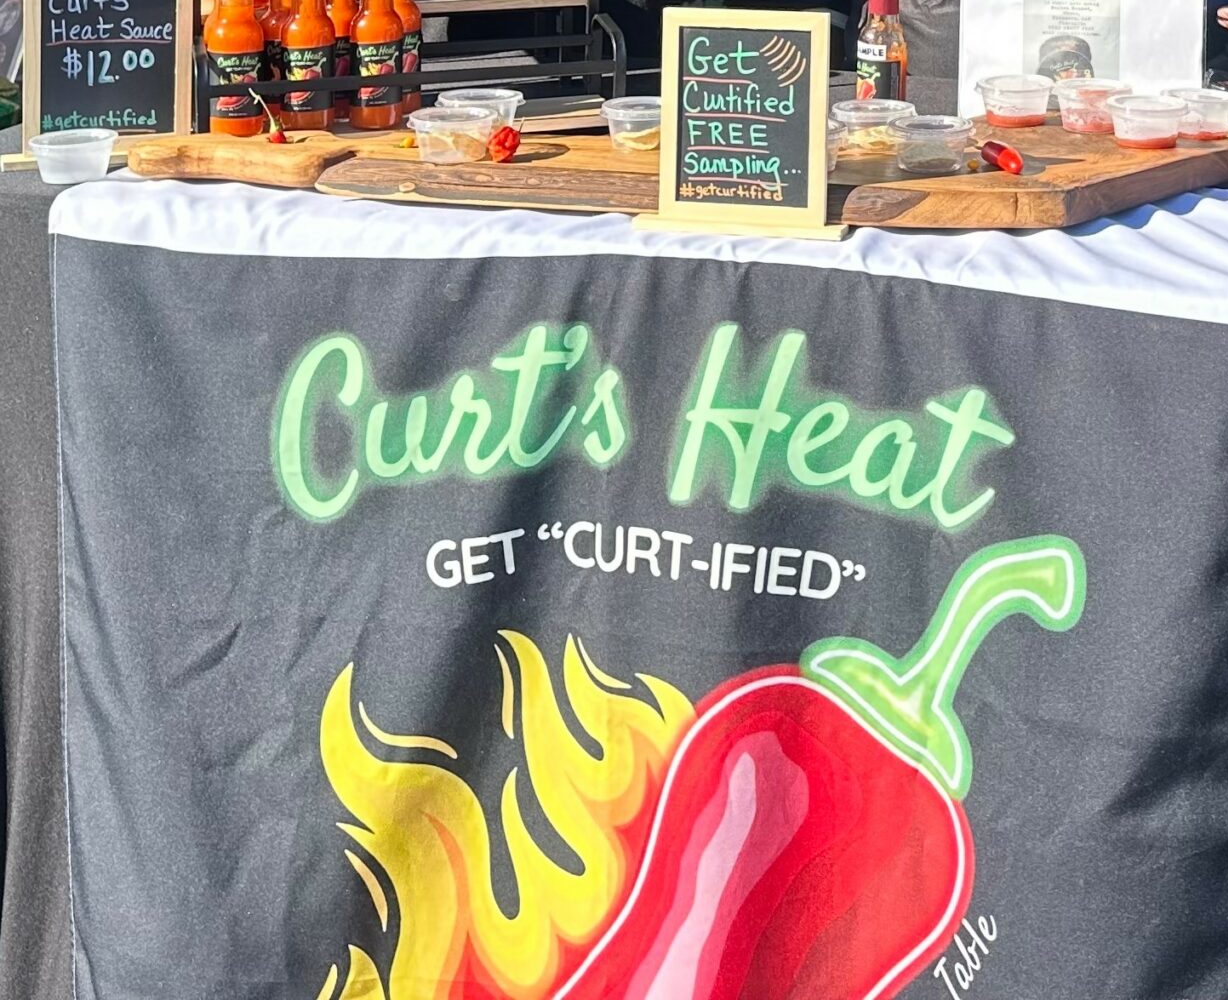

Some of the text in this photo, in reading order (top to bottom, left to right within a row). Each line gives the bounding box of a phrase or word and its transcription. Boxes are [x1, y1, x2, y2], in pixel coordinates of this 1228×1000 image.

[51, 16, 173, 43] Heat Sauce
[61, 46, 155, 87] $12.00
[687, 37, 760, 75] Get
[683, 81, 795, 116] Curtified
[42, 109, 157, 129] #getcurtified
[687, 119, 768, 147] FREE
[679, 182, 783, 202] #getcurtified
[274, 323, 1016, 530] Curt's Heat
[426, 521, 865, 601] GET "CURT-IFIED"
[933, 914, 997, 1000] Table
